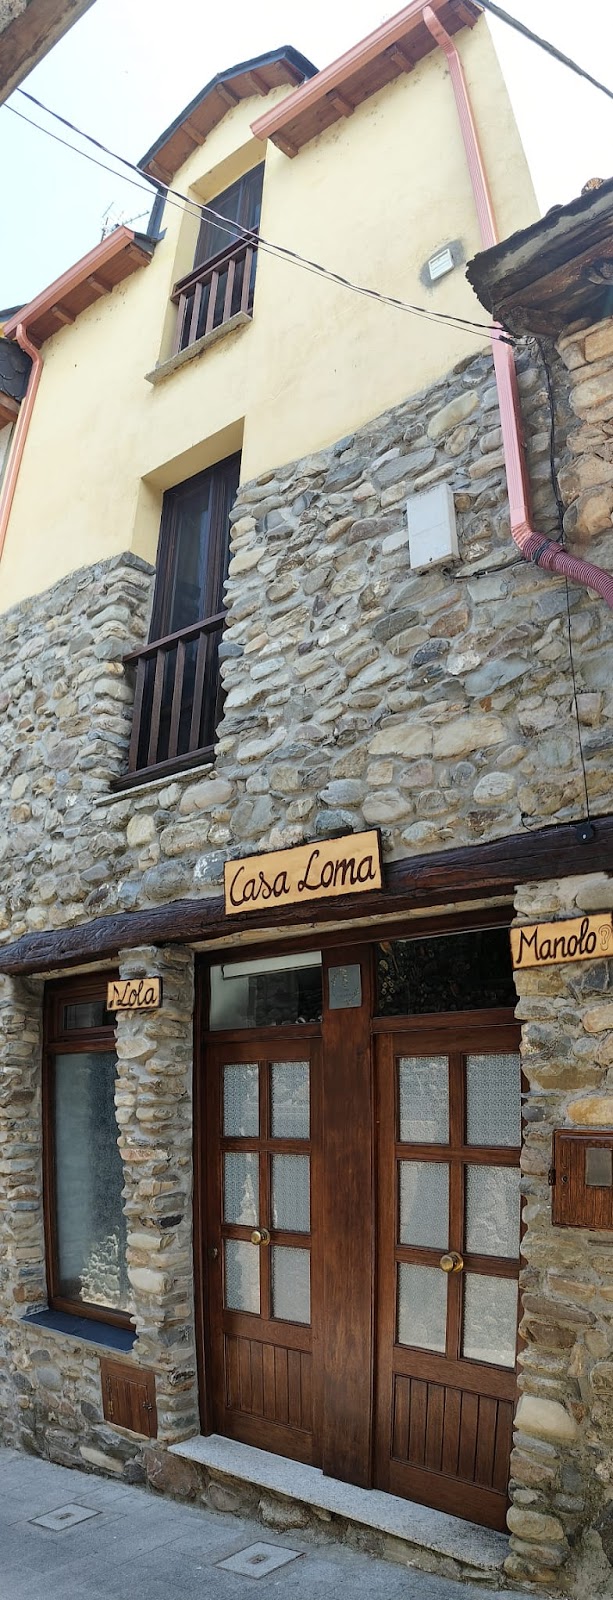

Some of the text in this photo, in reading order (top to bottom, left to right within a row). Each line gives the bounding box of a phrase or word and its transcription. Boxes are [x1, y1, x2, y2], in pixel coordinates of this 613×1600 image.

[229, 849, 376, 906] Casa Loma
[516, 917, 597, 964] Manolo
[116, 980, 158, 1007] Lola
